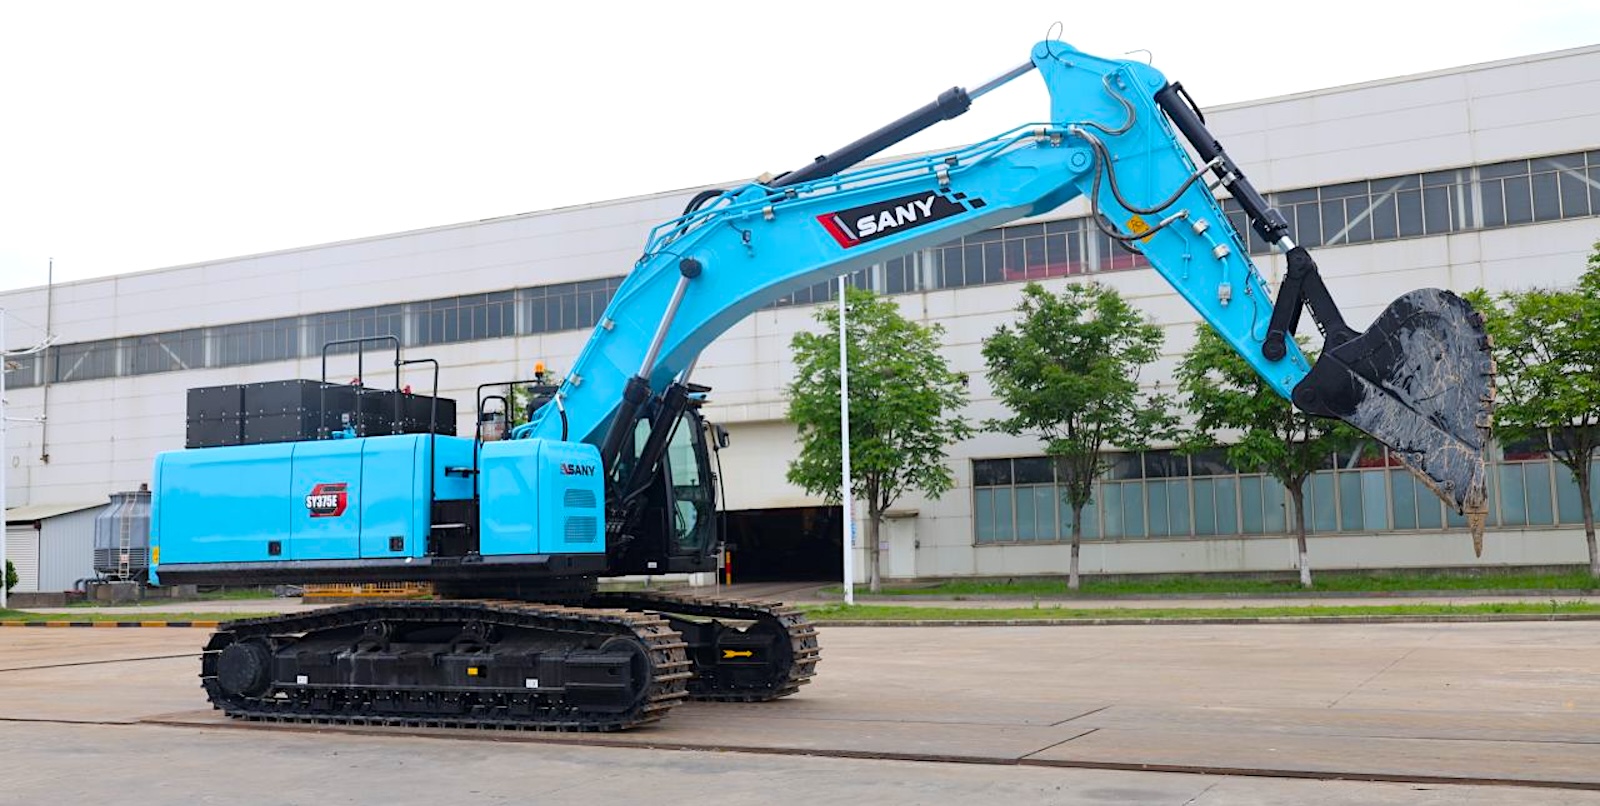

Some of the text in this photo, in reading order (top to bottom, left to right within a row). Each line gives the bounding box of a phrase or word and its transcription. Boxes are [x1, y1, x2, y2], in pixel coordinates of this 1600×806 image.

[856, 196, 935, 237] SANY
[567, 464, 595, 476] SANY
[306, 495, 337, 508] SY375E
